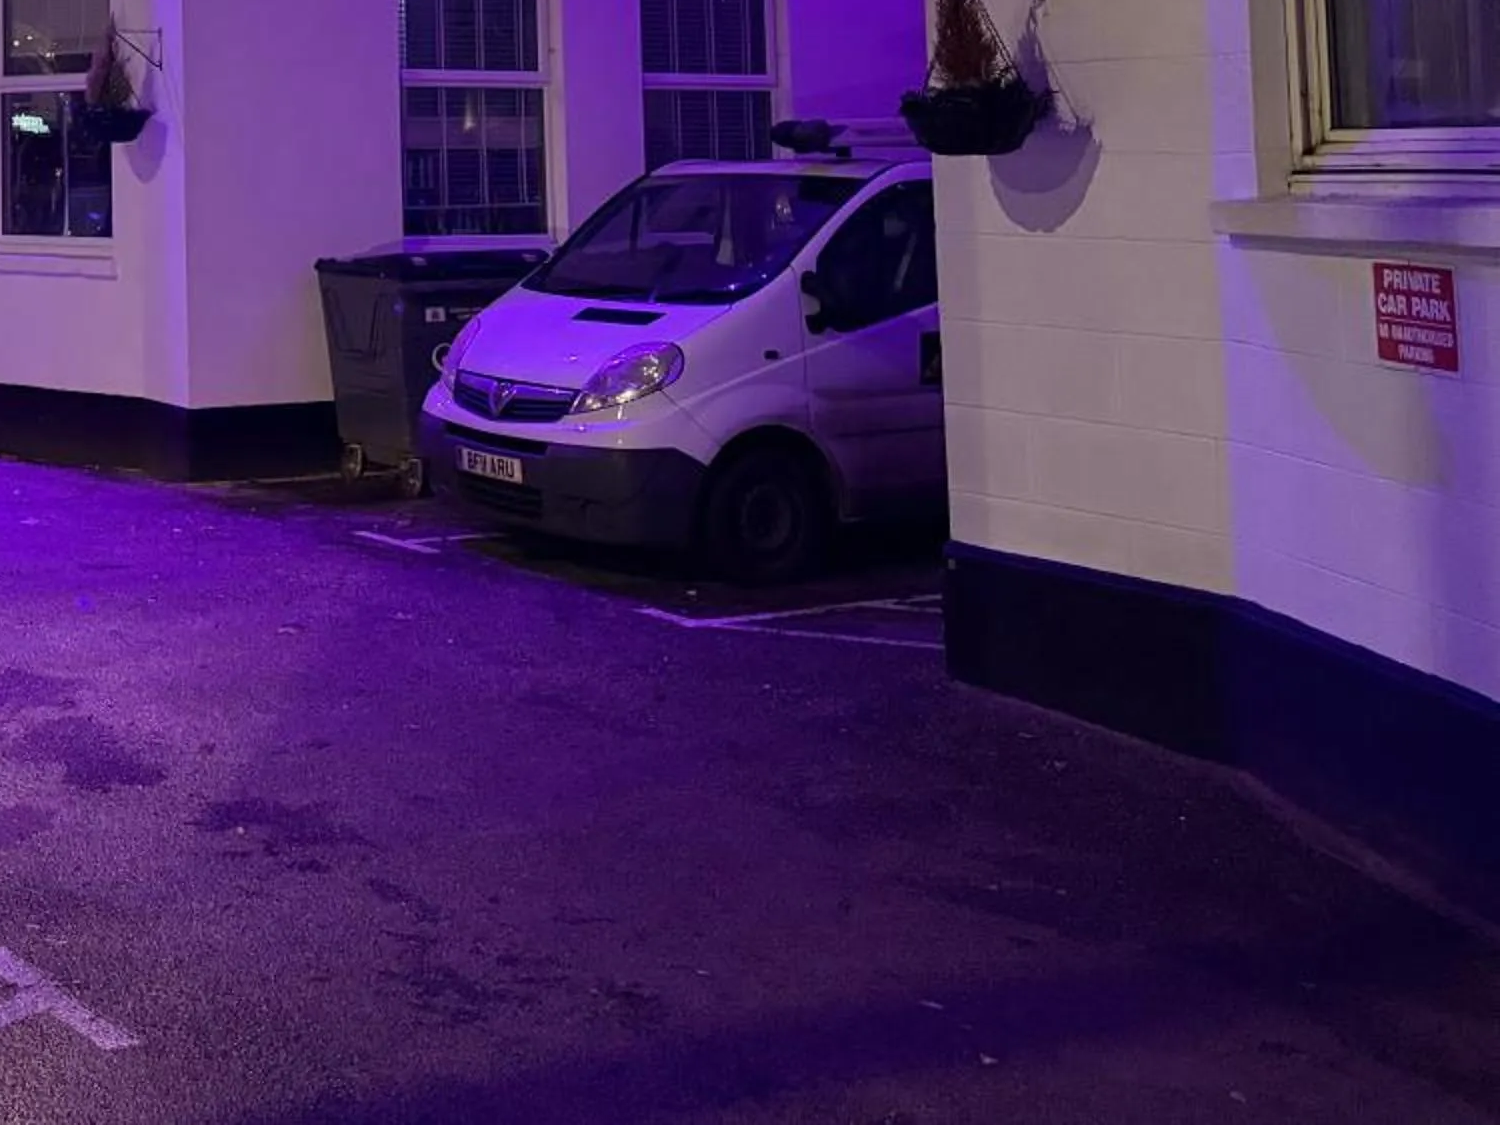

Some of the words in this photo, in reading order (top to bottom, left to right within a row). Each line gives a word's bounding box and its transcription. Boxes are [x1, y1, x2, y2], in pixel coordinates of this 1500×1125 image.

[1383, 268, 1441, 294] PRIVATE
[1378, 293, 1407, 316] CAR
[1411, 296, 1451, 322] PARK
